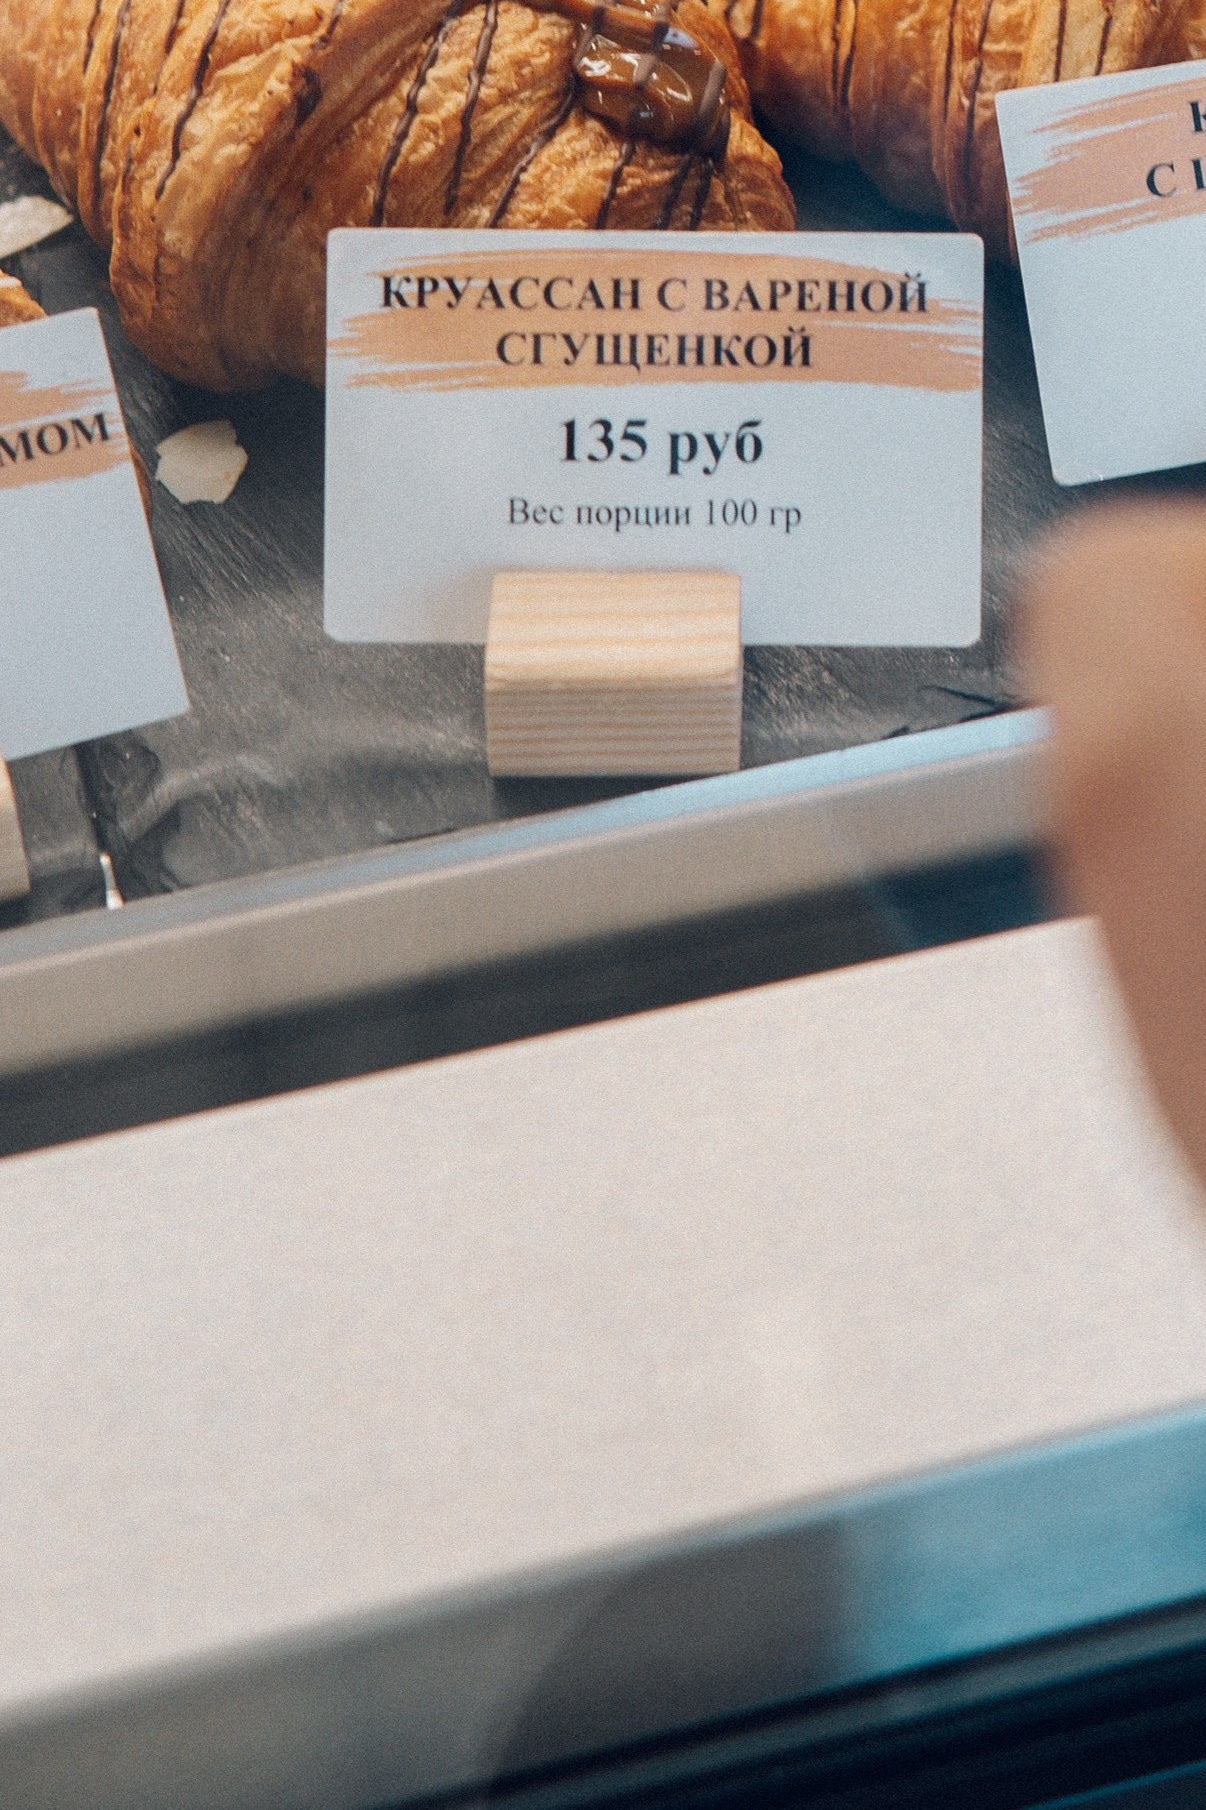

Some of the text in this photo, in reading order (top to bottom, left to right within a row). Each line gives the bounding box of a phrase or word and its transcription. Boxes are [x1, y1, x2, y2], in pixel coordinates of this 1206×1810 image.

[1146, 161, 1178, 198] С
[380, 272, 928, 314] КРУАССАН С ВАРЕНОЙ
[496, 325, 813, 371] СГУЩЕНКОЙ
[559, 418, 764, 476] 135 руб
[508, 498, 802, 533] Вес порции 100 гр
